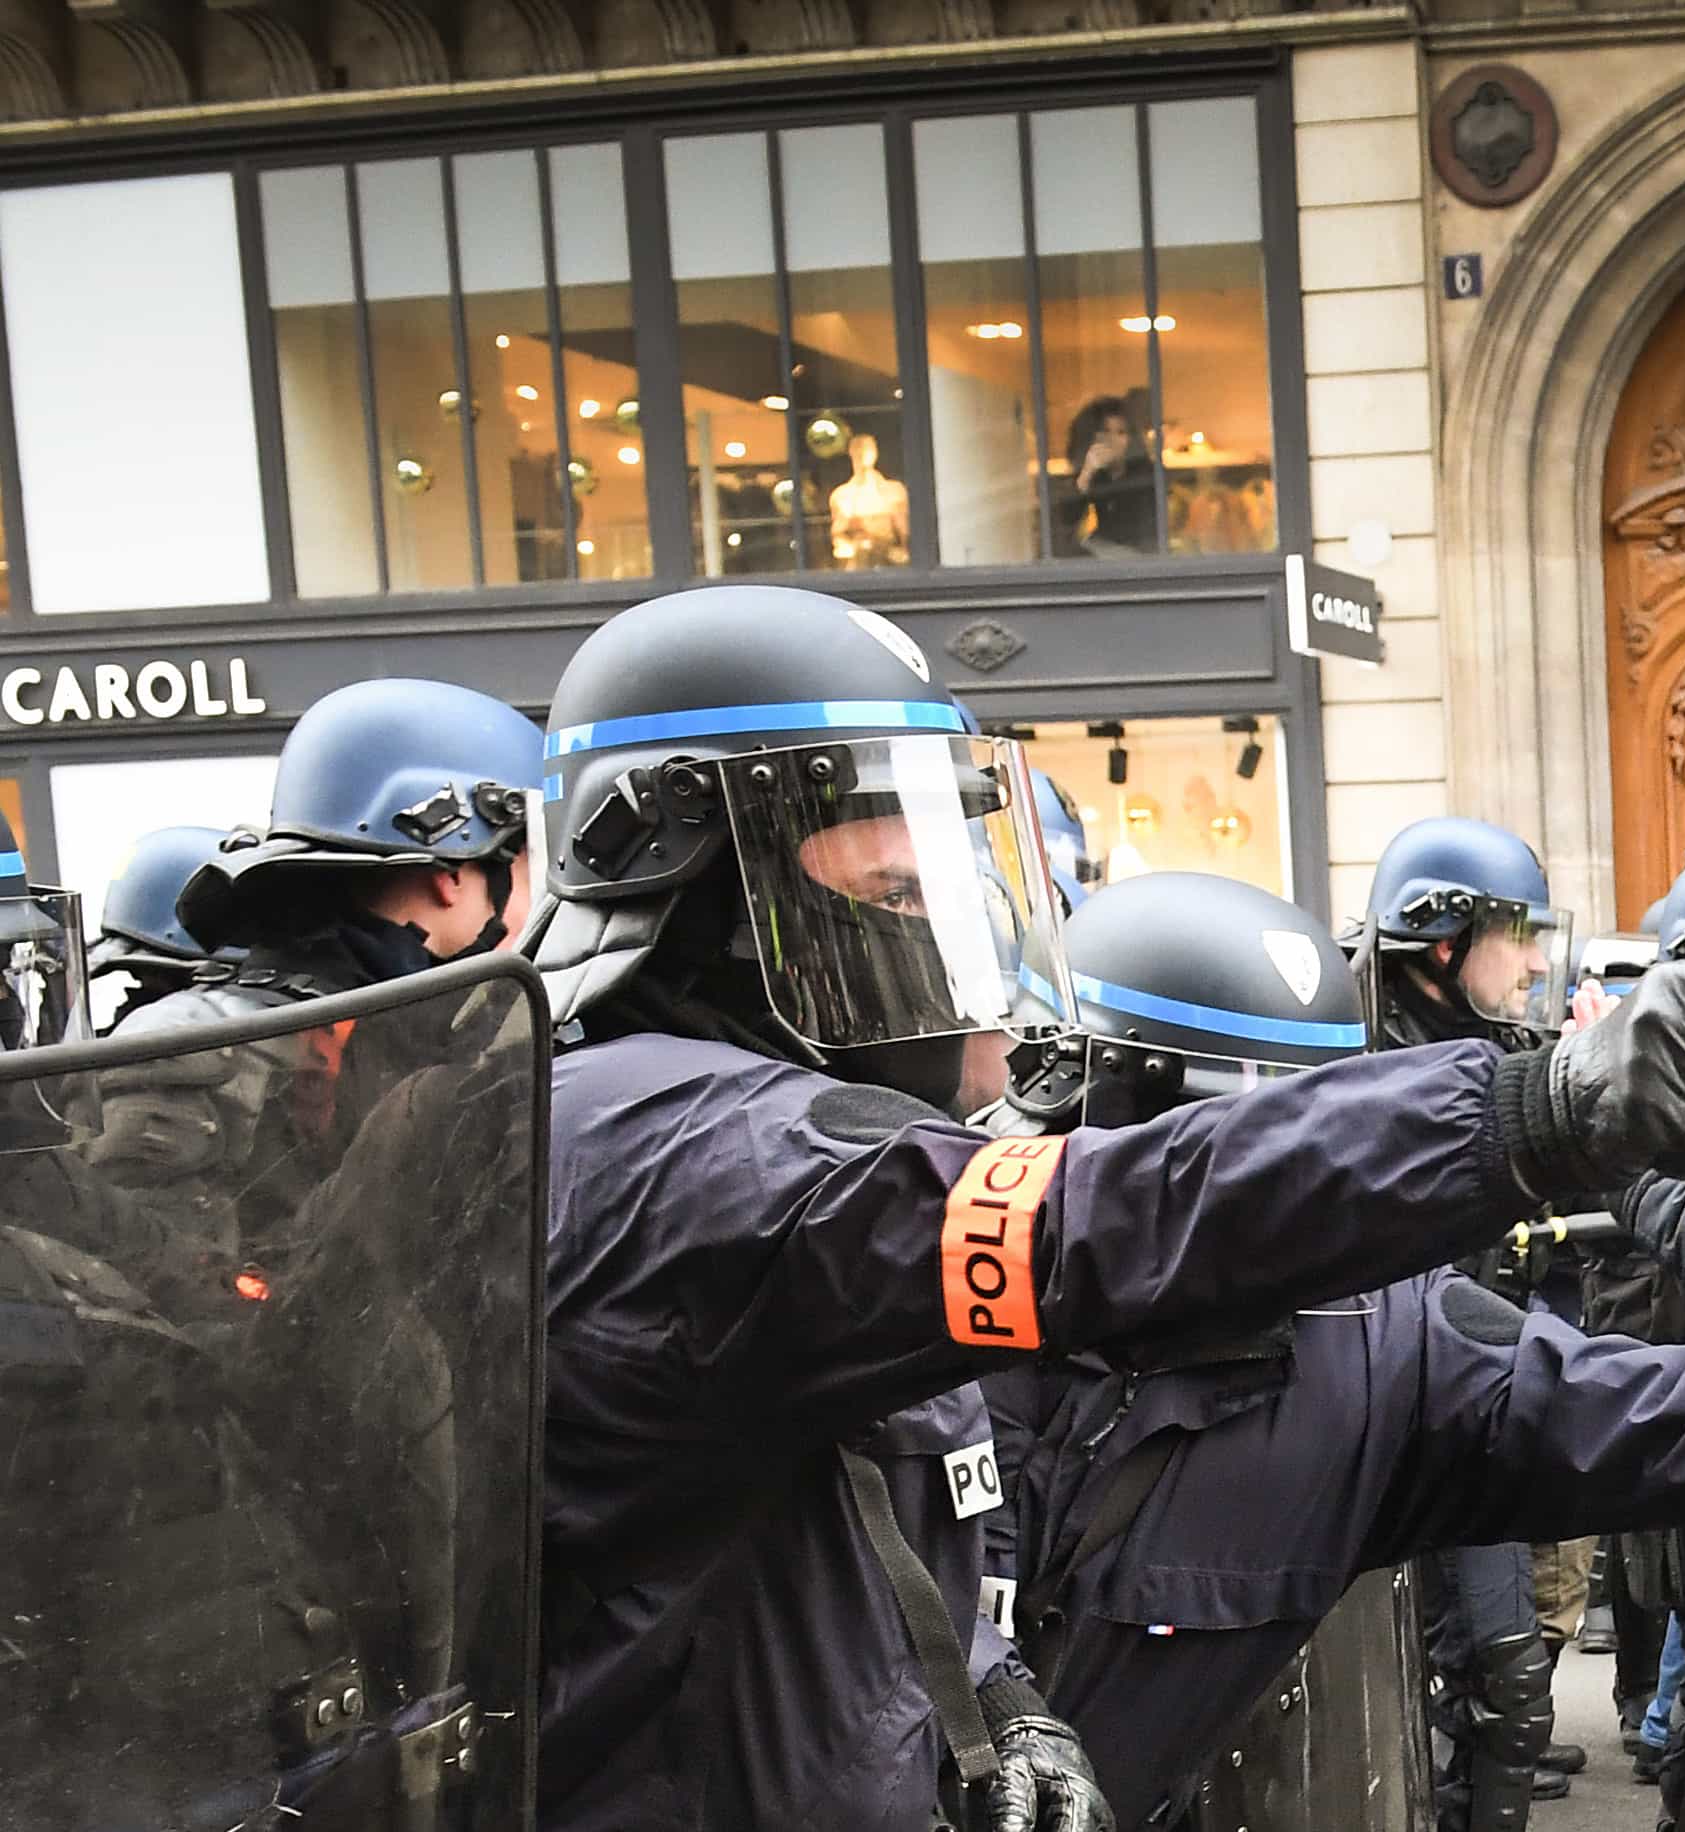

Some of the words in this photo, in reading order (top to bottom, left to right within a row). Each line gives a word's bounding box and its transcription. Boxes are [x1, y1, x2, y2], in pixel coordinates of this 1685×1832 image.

[1455, 259, 1472, 294] 6
[1, 657, 267, 725] CAROLL
[964, 1142, 1049, 1338] POLICE
